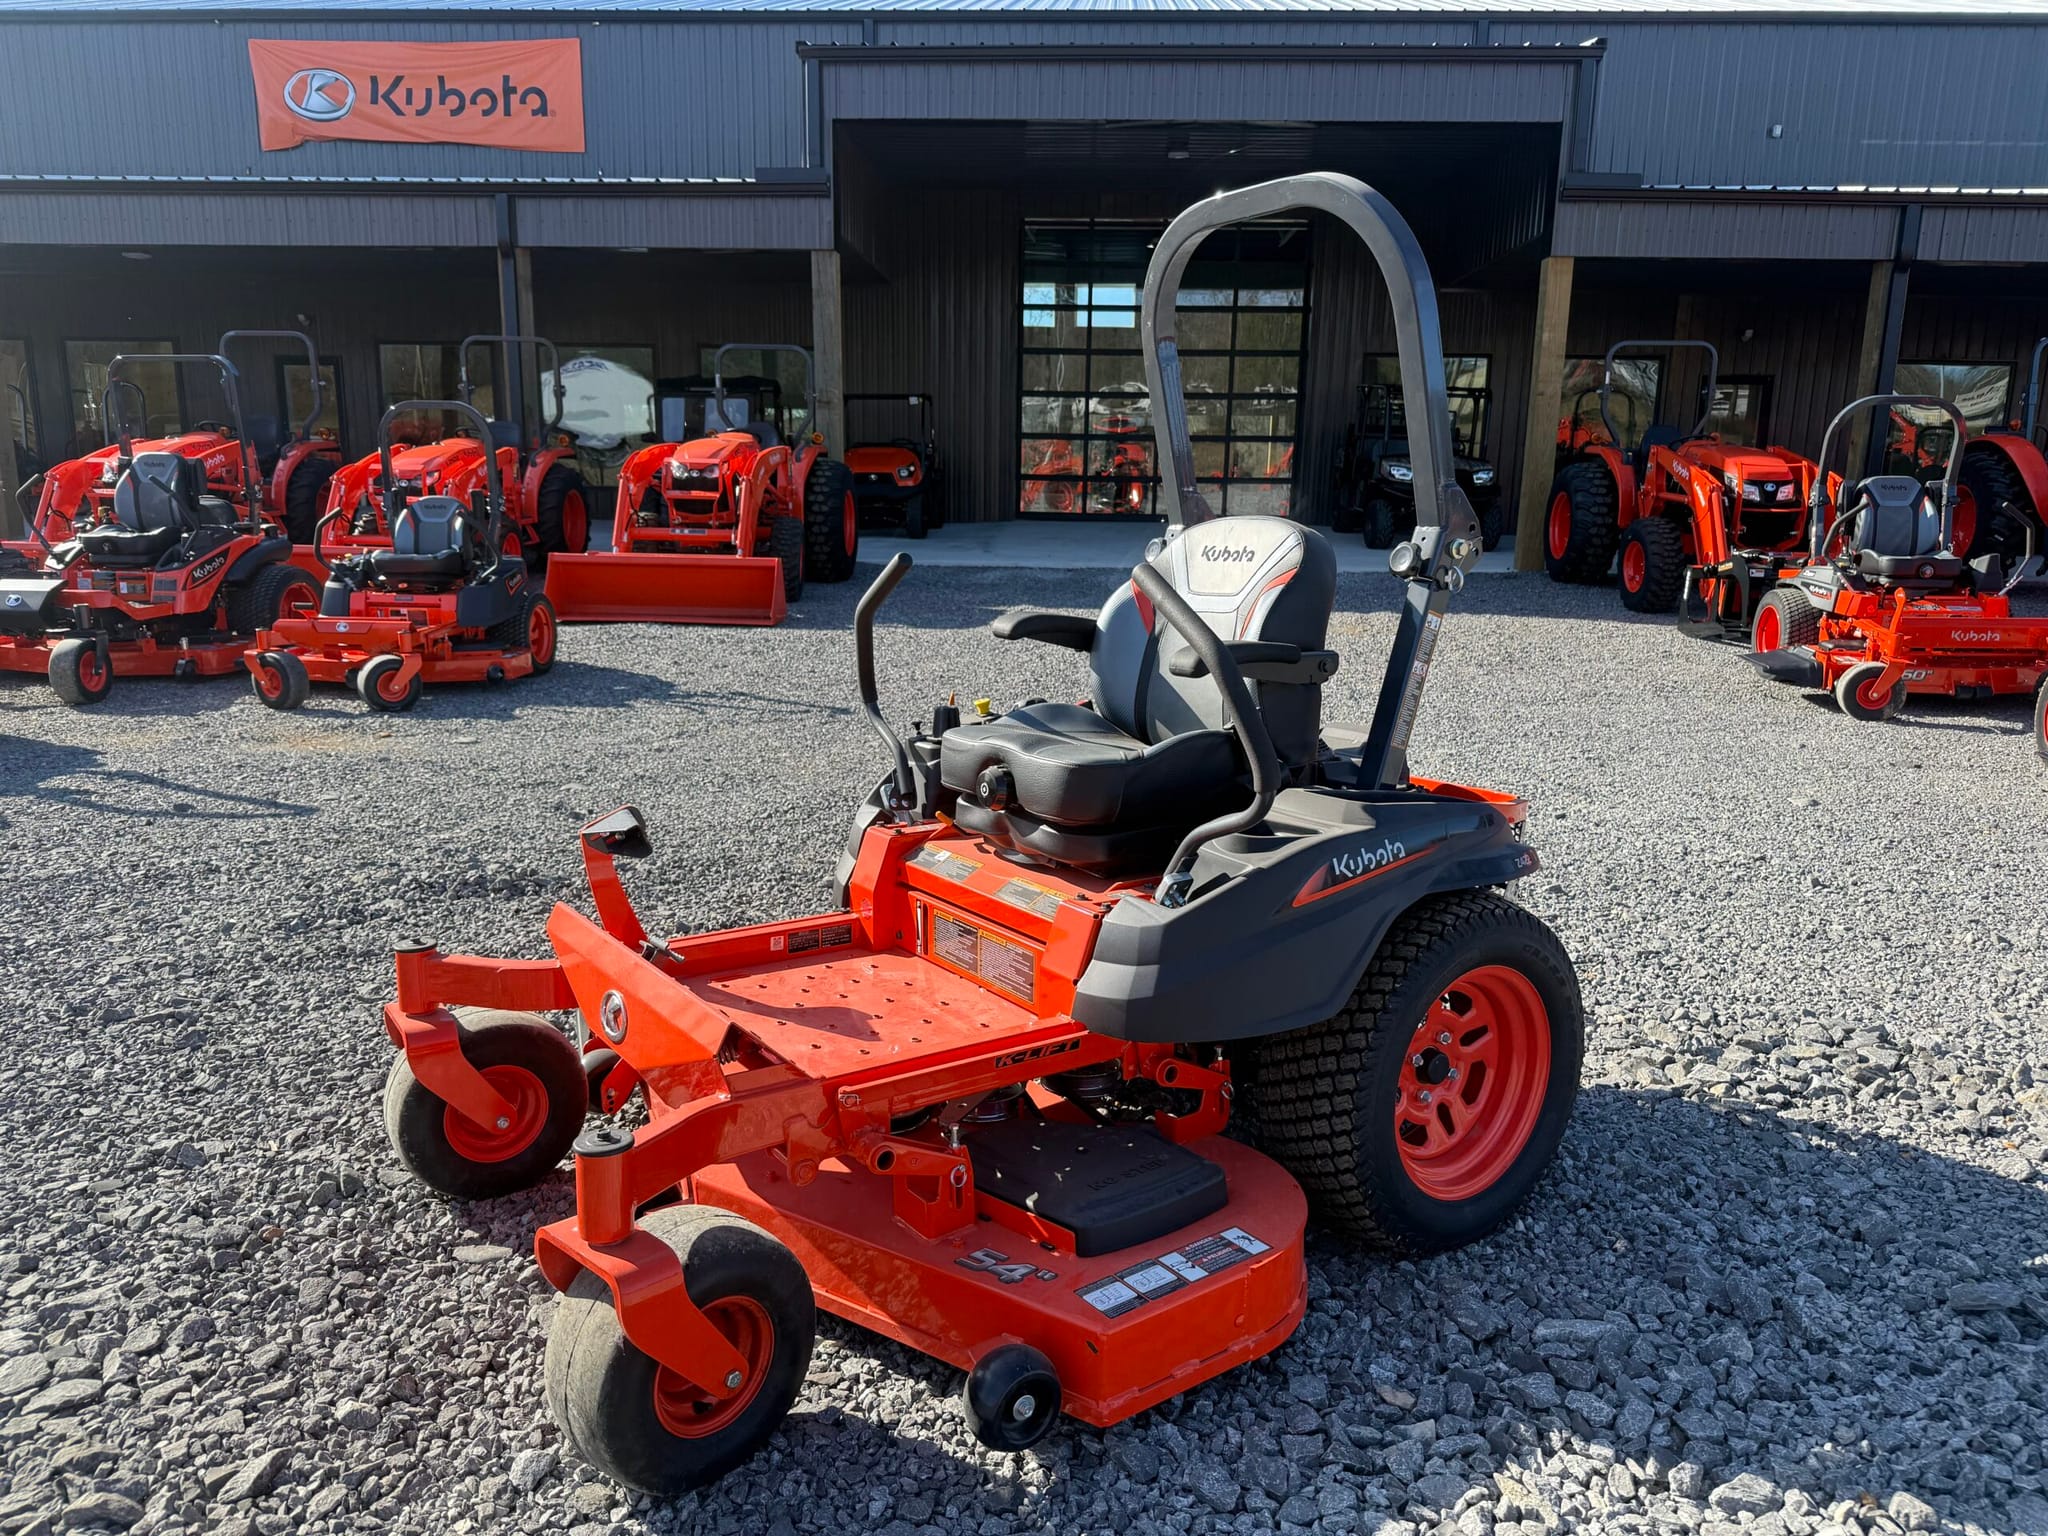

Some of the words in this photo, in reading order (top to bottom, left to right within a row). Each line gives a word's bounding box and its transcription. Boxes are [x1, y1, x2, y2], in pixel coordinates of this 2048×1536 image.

[369, 74, 549, 117] Kubota
[1200, 545, 1256, 562] Kubota
[192, 556, 226, 578] Kubota
[1951, 630, 2001, 642] Kubota
[1332, 839, 1406, 877] Kubota
[997, 1039, 1077, 1067] K-LIFT
